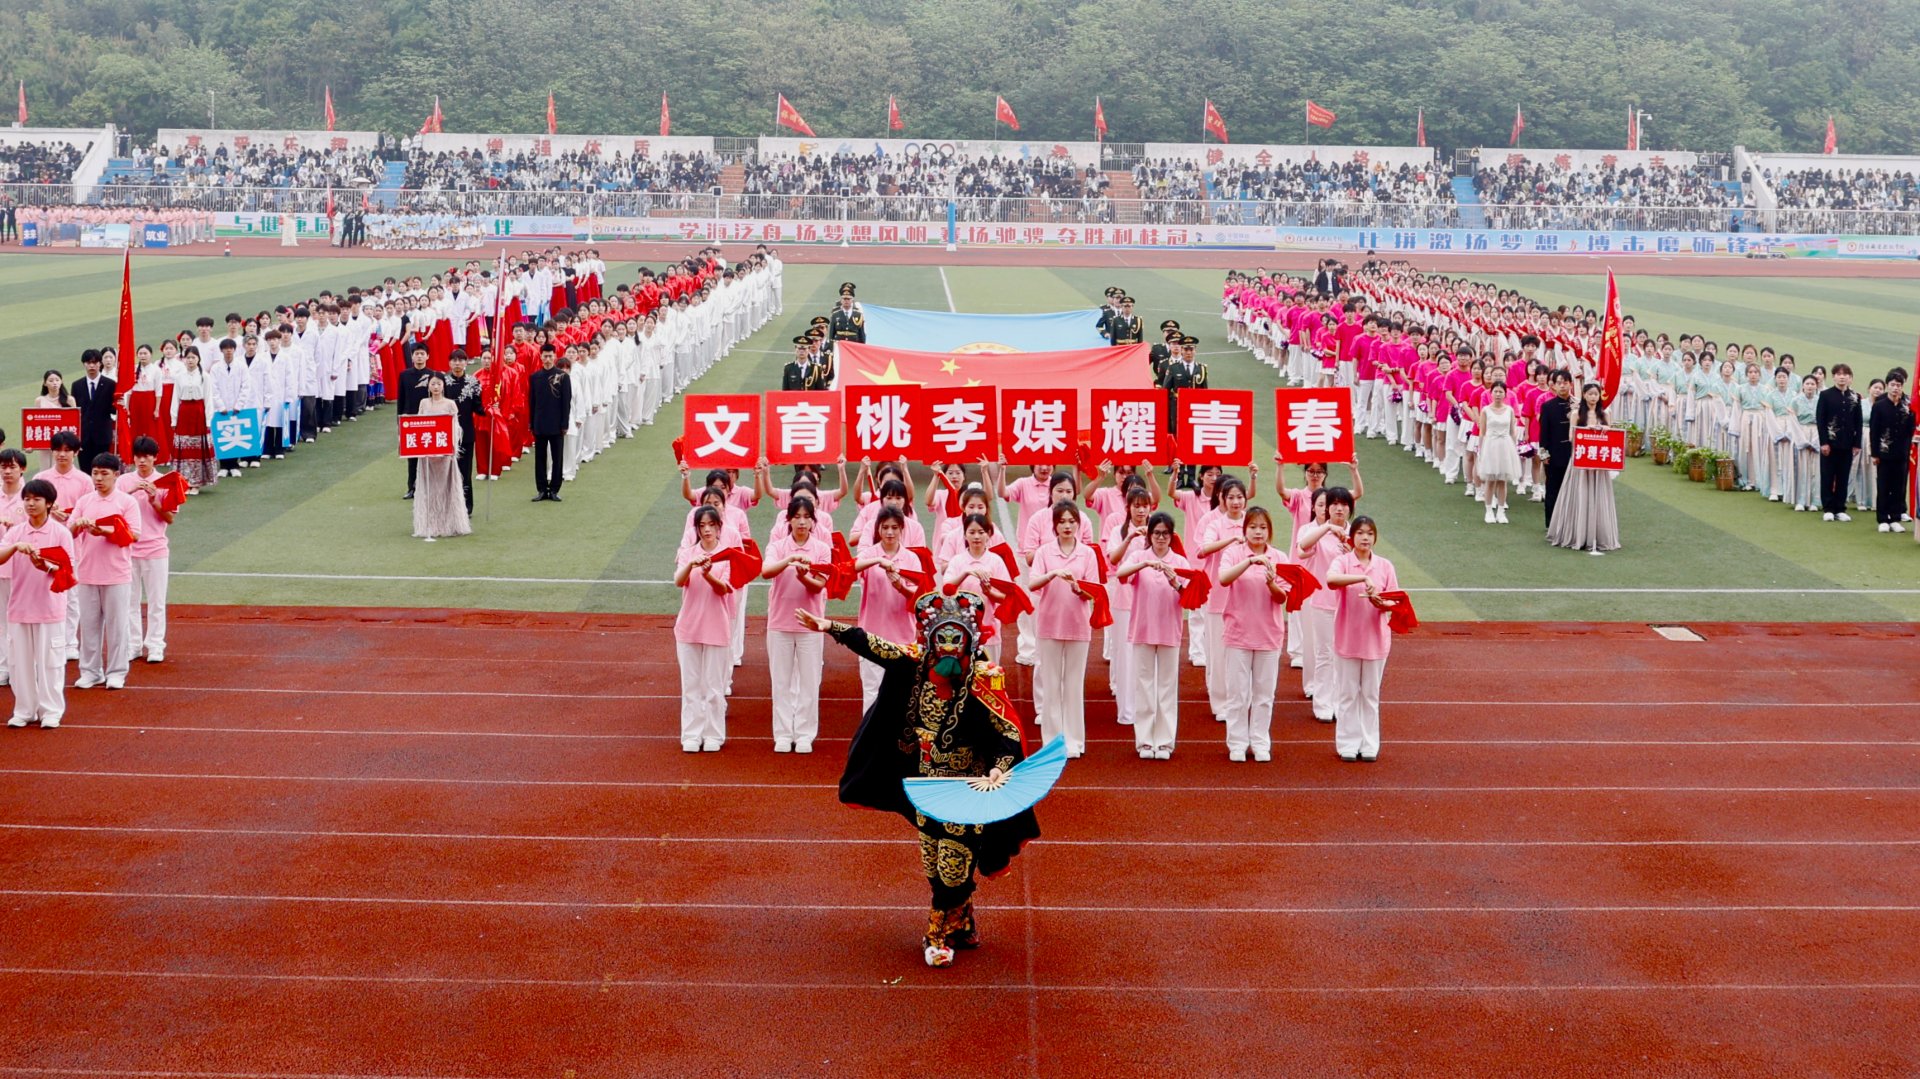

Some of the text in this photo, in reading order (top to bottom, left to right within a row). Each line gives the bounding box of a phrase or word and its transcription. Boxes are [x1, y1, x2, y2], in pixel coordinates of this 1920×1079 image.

[486, 138, 650, 157] 增强体质
[679, 222, 783, 241] 学海泛舟
[796, 223, 927, 242] 扬梦想风帆
[1057, 227, 1188, 245] 夺胜利桂冠
[1358, 231, 1559, 250] 比拼激扬梦想
[216, 415, 253, 452] 实
[405, 431, 448, 449] 医学院
[1575, 444, 1622, 463] 护理学院
